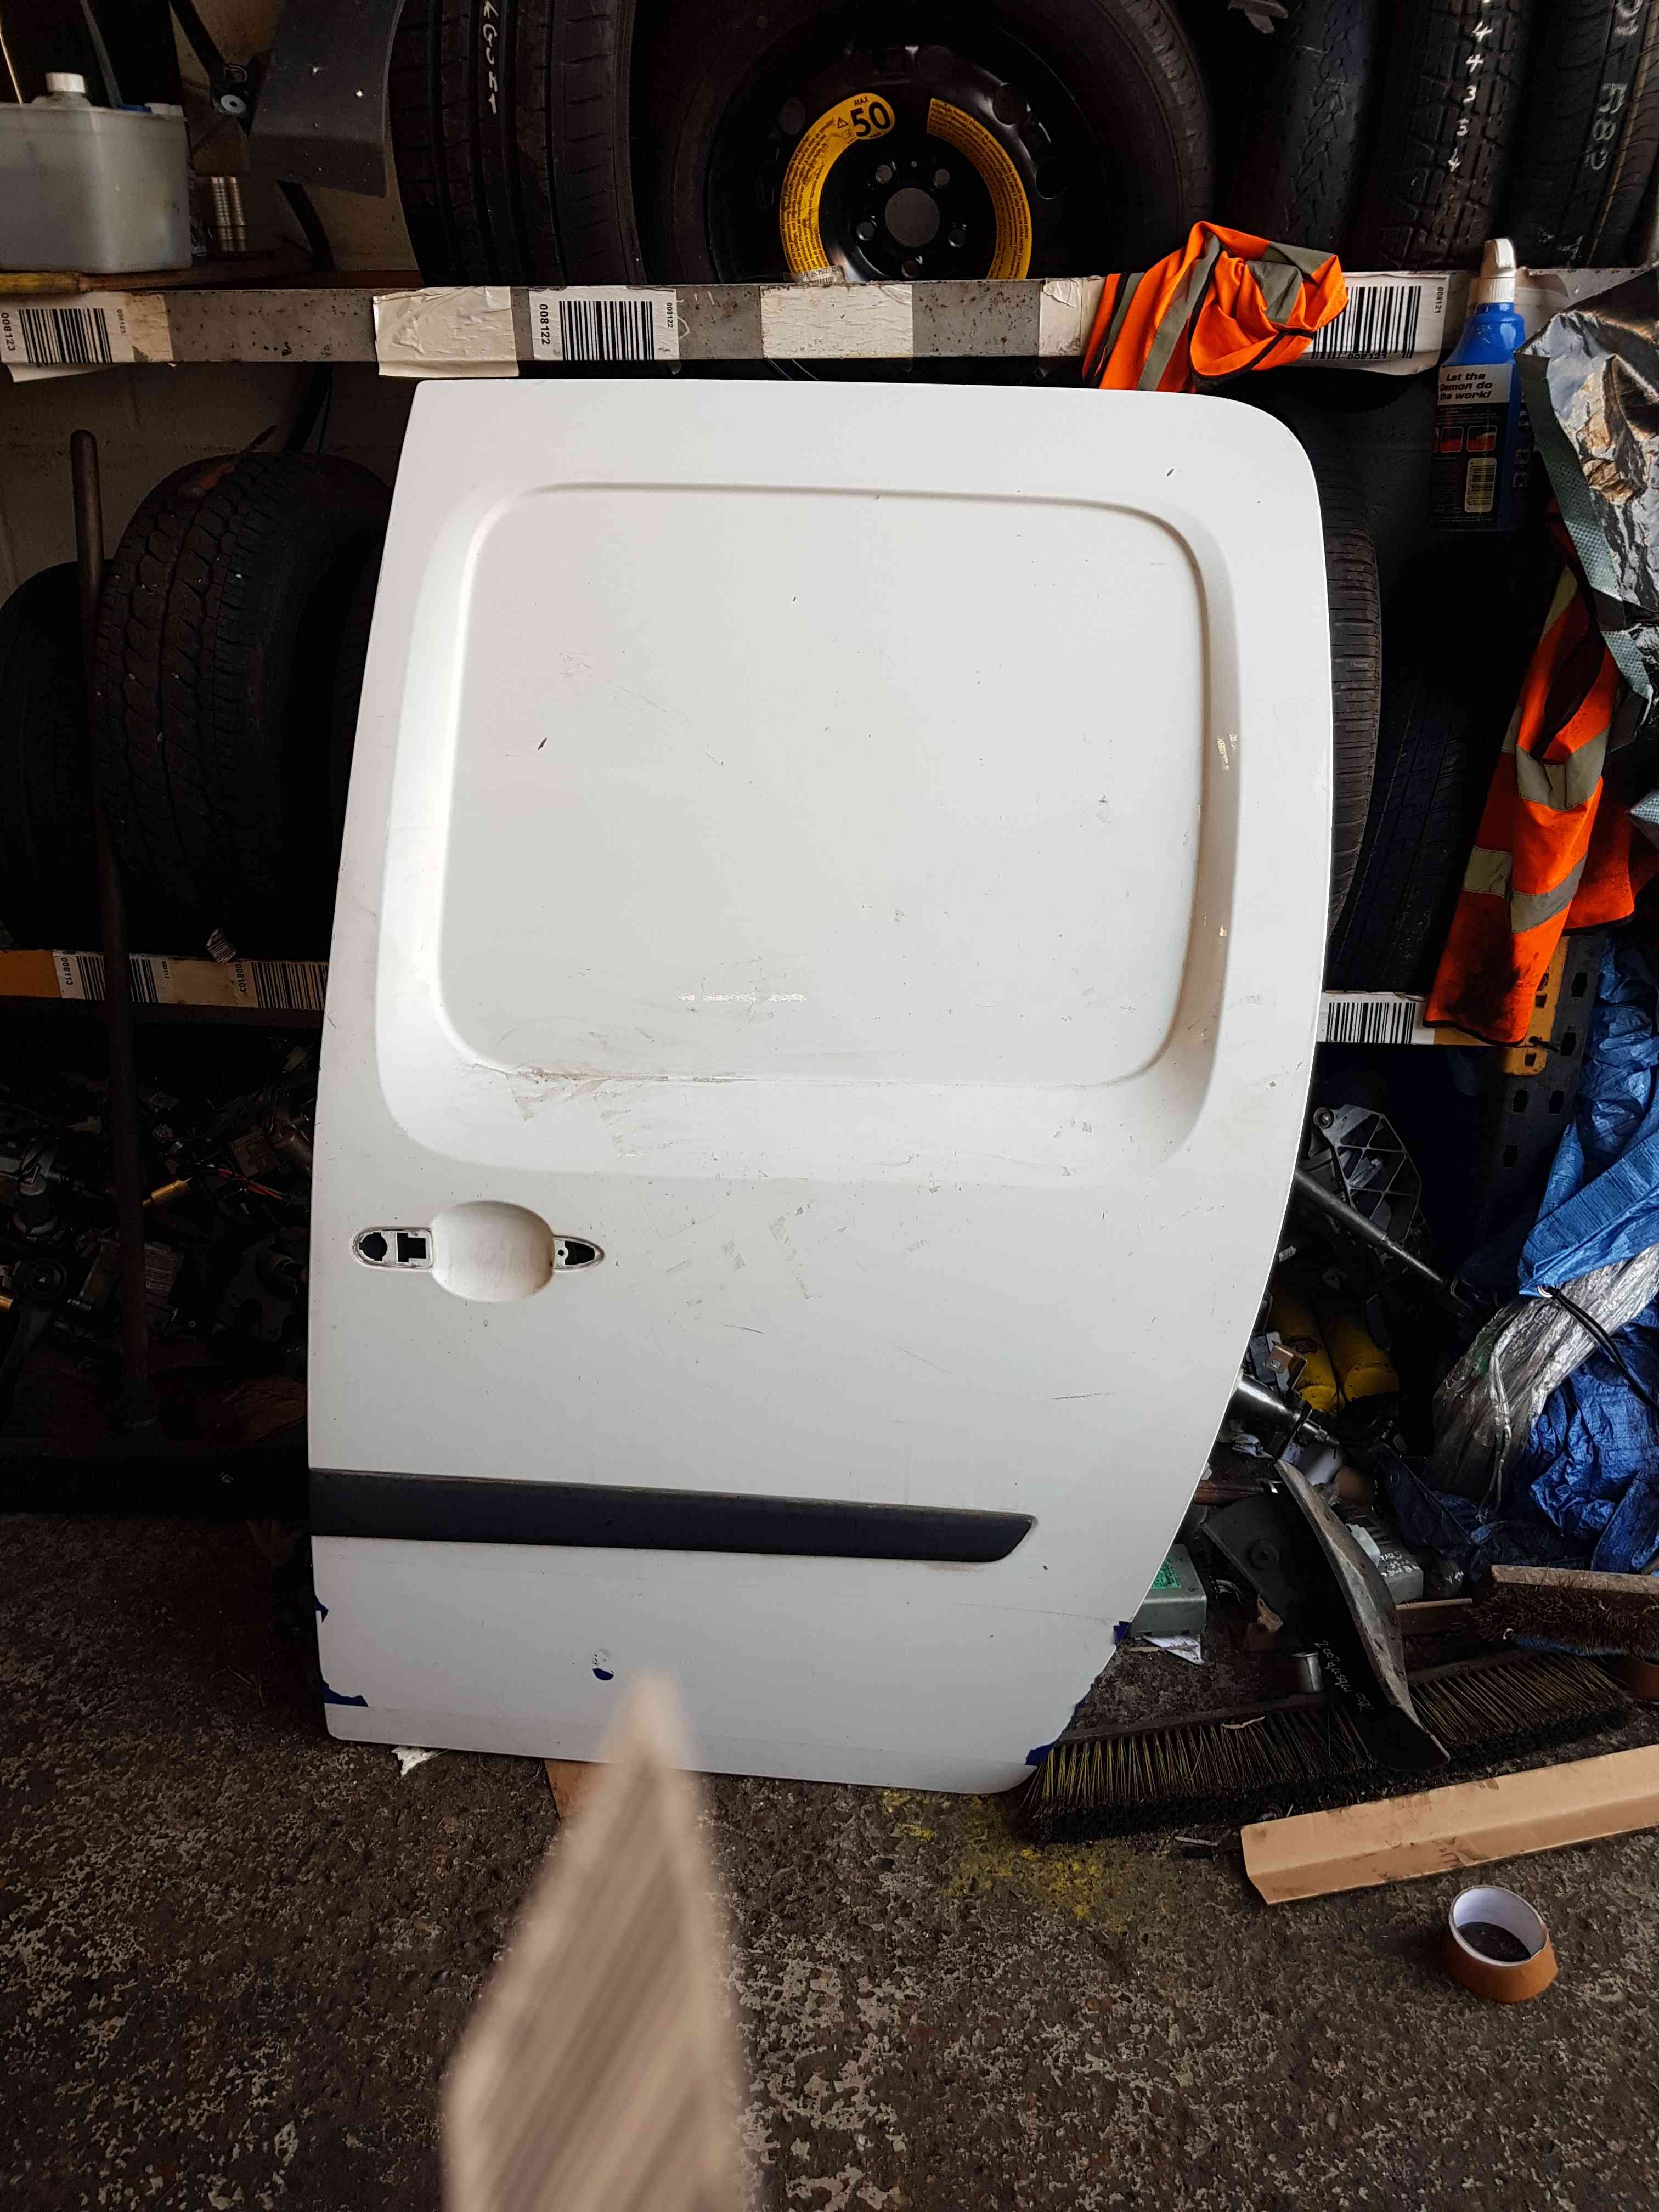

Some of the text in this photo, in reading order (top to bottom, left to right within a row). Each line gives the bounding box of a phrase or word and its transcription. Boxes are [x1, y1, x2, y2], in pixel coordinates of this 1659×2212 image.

[854, 95, 869, 106] MAX
[850, 101, 891, 137] 50
[1434, 286, 1444, 314] 008121
[116, 309, 127, 334] 008123
[539, 304, 551, 345] 008122
[666, 302, 674, 328] 008122
[1, 312, 16, 352] 008123
[1455, 390, 1492, 399] work!
[61, 957, 74, 986] 008113
[235, 963, 247, 992] 008103
